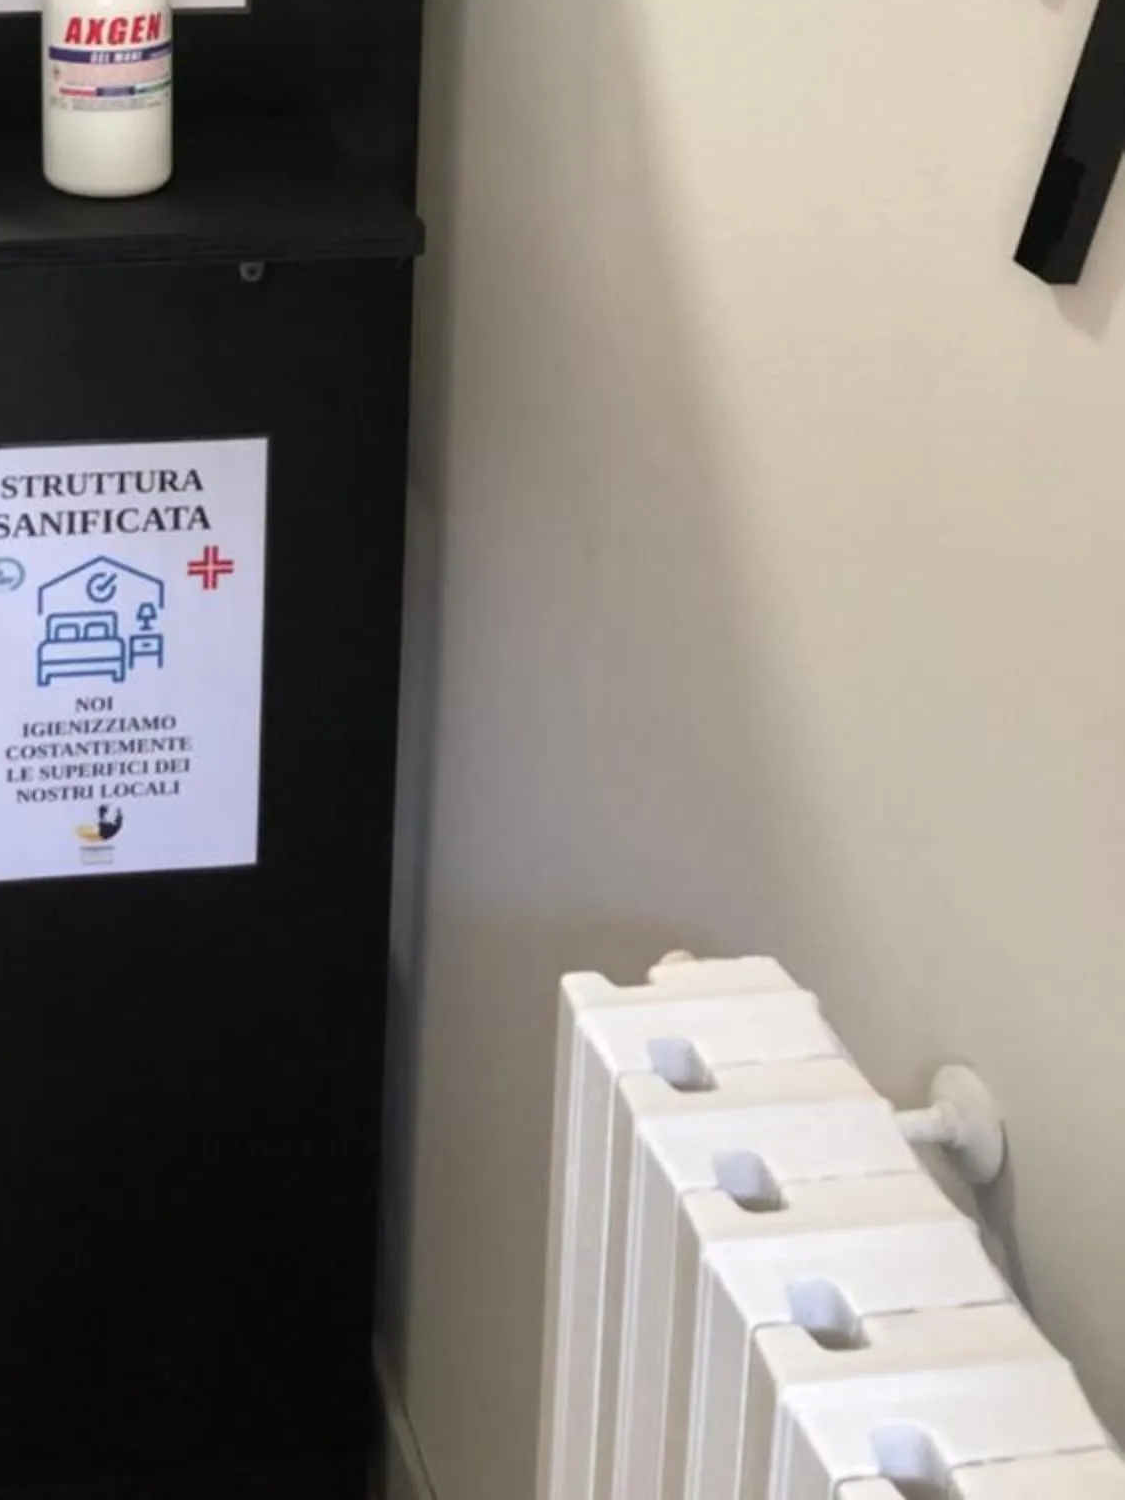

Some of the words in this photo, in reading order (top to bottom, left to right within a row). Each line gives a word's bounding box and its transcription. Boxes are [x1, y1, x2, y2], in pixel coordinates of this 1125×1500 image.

[64, 11, 162, 46] AXGEN
[1, 468, 204, 500] STRUTTURA
[75, 696, 113, 712] NOI
[22, 715, 178, 738] IGIENIZZIAMO
[5, 736, 192, 761] COSTANTEMENTE
[6, 768, 34, 783] LE
[39, 760, 148, 781] SUPERFICI
[155, 758, 191, 775] DEI
[16, 784, 94, 804] NOSTRI
[100, 779, 180, 799] LOCALI
